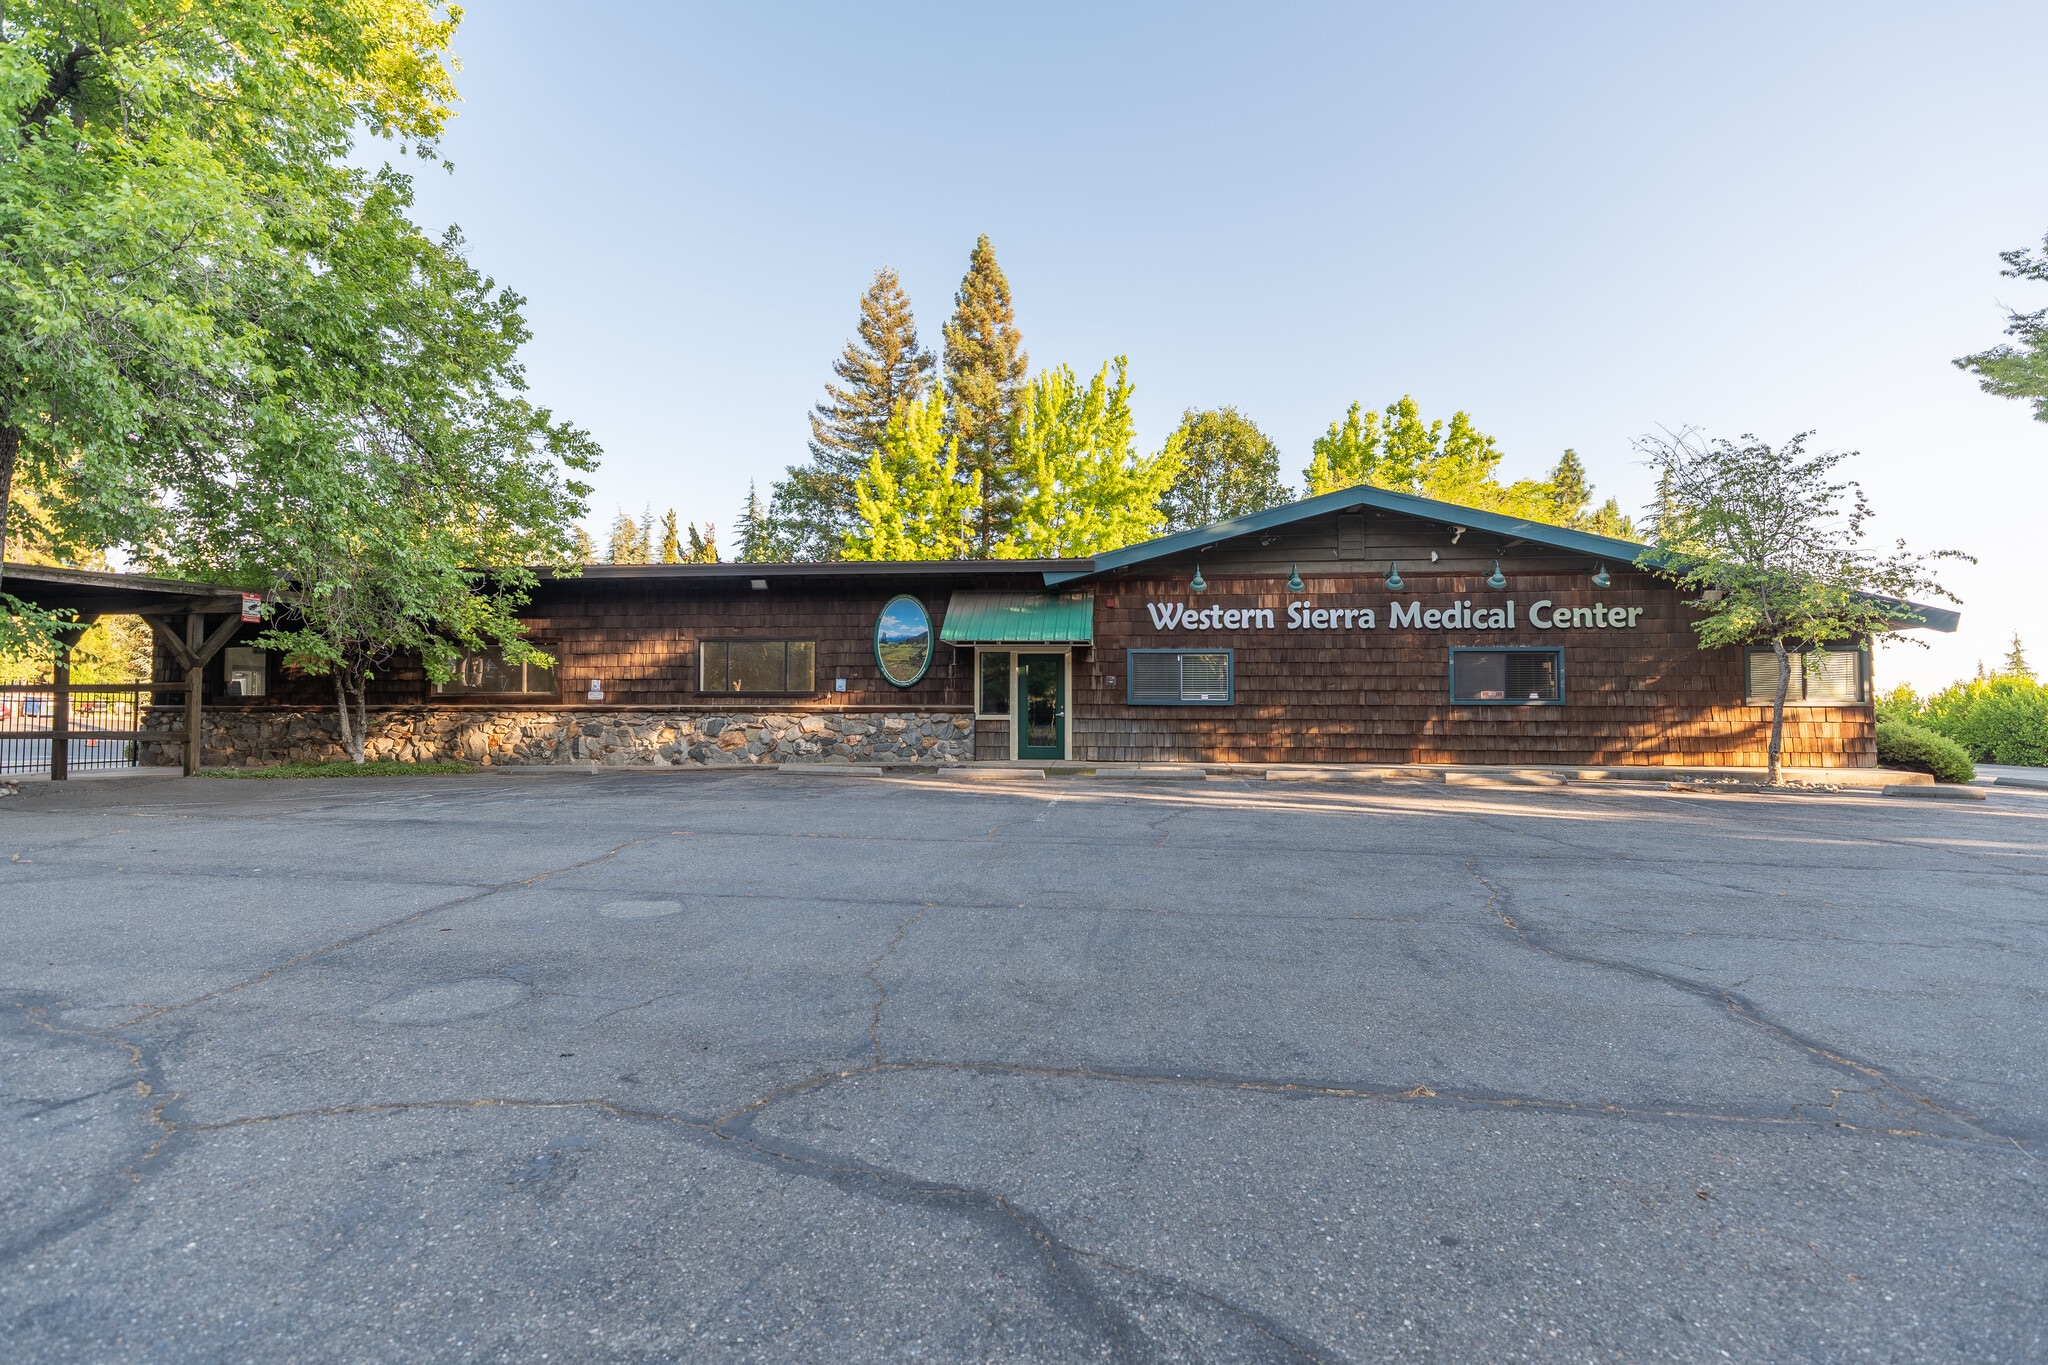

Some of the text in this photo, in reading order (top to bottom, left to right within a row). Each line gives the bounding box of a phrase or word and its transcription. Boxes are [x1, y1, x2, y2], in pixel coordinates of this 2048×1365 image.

[1147, 600, 1643, 630] Western Sierra Medical Center
